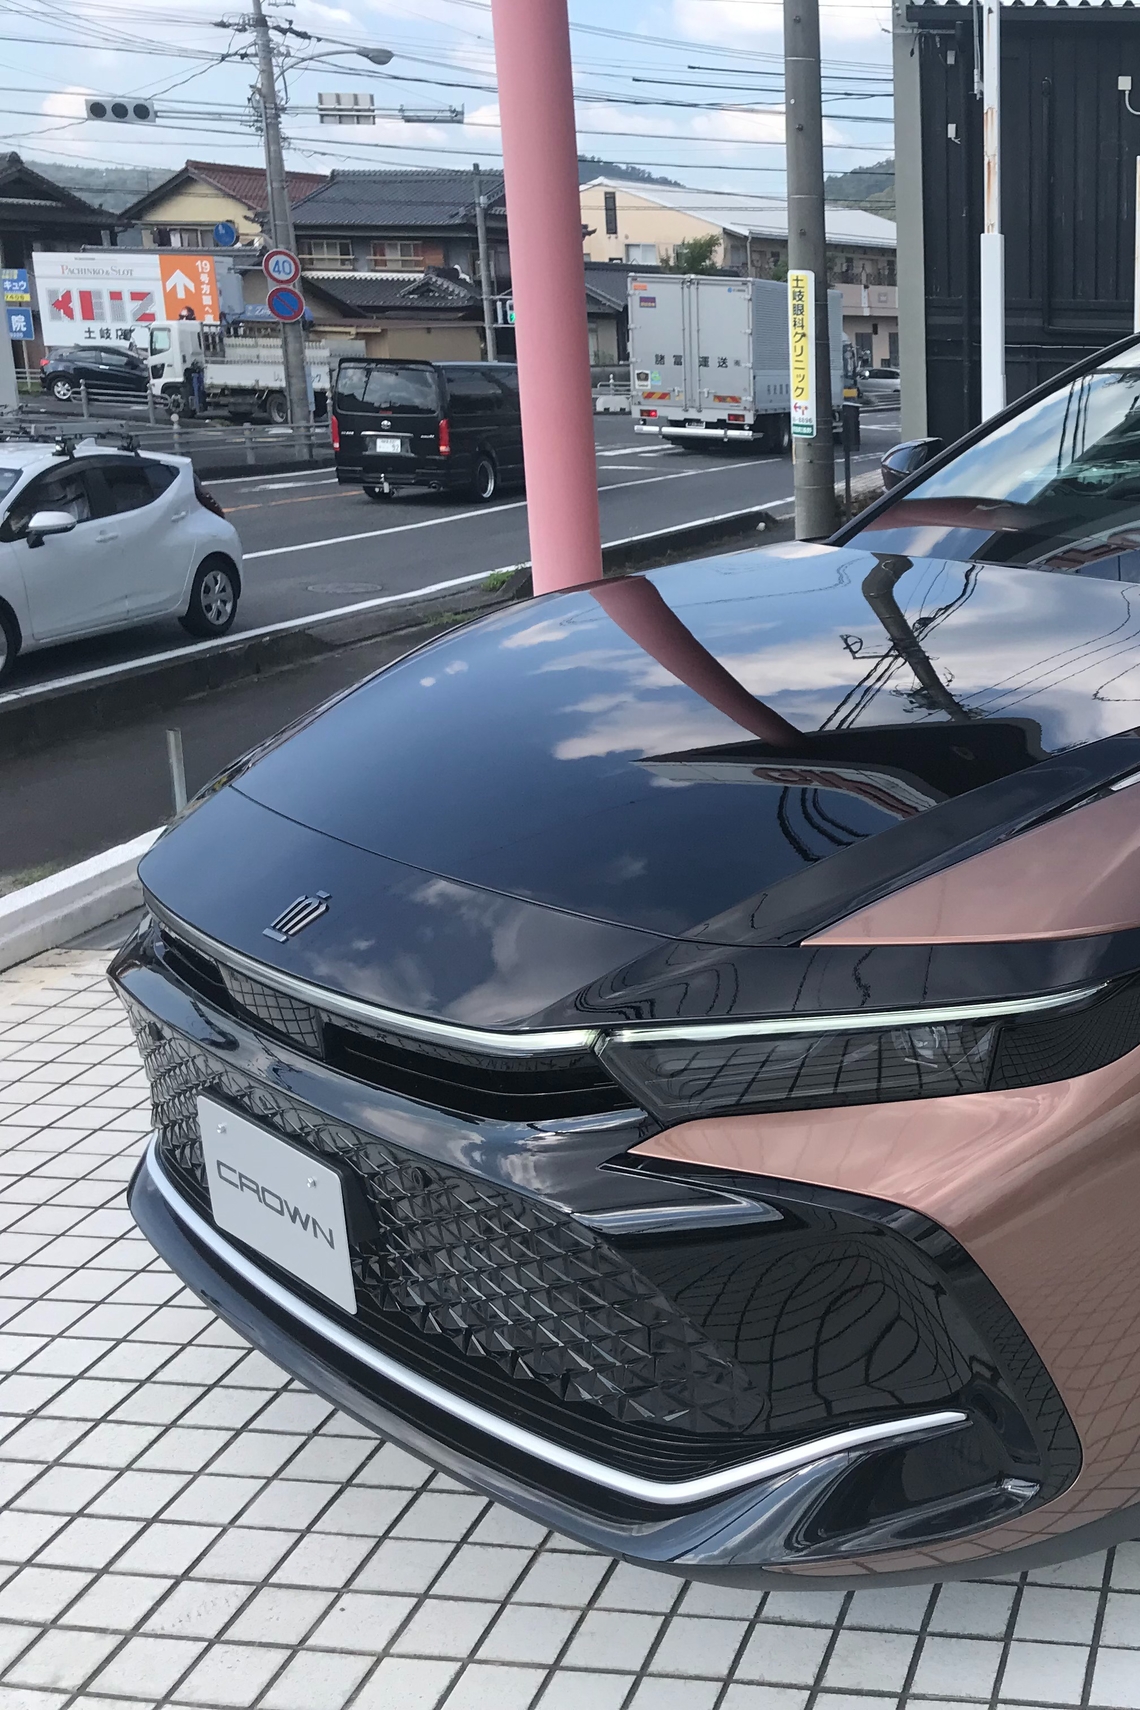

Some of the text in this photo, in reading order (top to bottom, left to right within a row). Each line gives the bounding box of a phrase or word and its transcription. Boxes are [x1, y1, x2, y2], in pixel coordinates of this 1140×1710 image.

[272, 260, 293, 276] 40
[791, 275, 806, 398] 土岐眼科クリニック
[216, 1159, 335, 1250] CROWN
